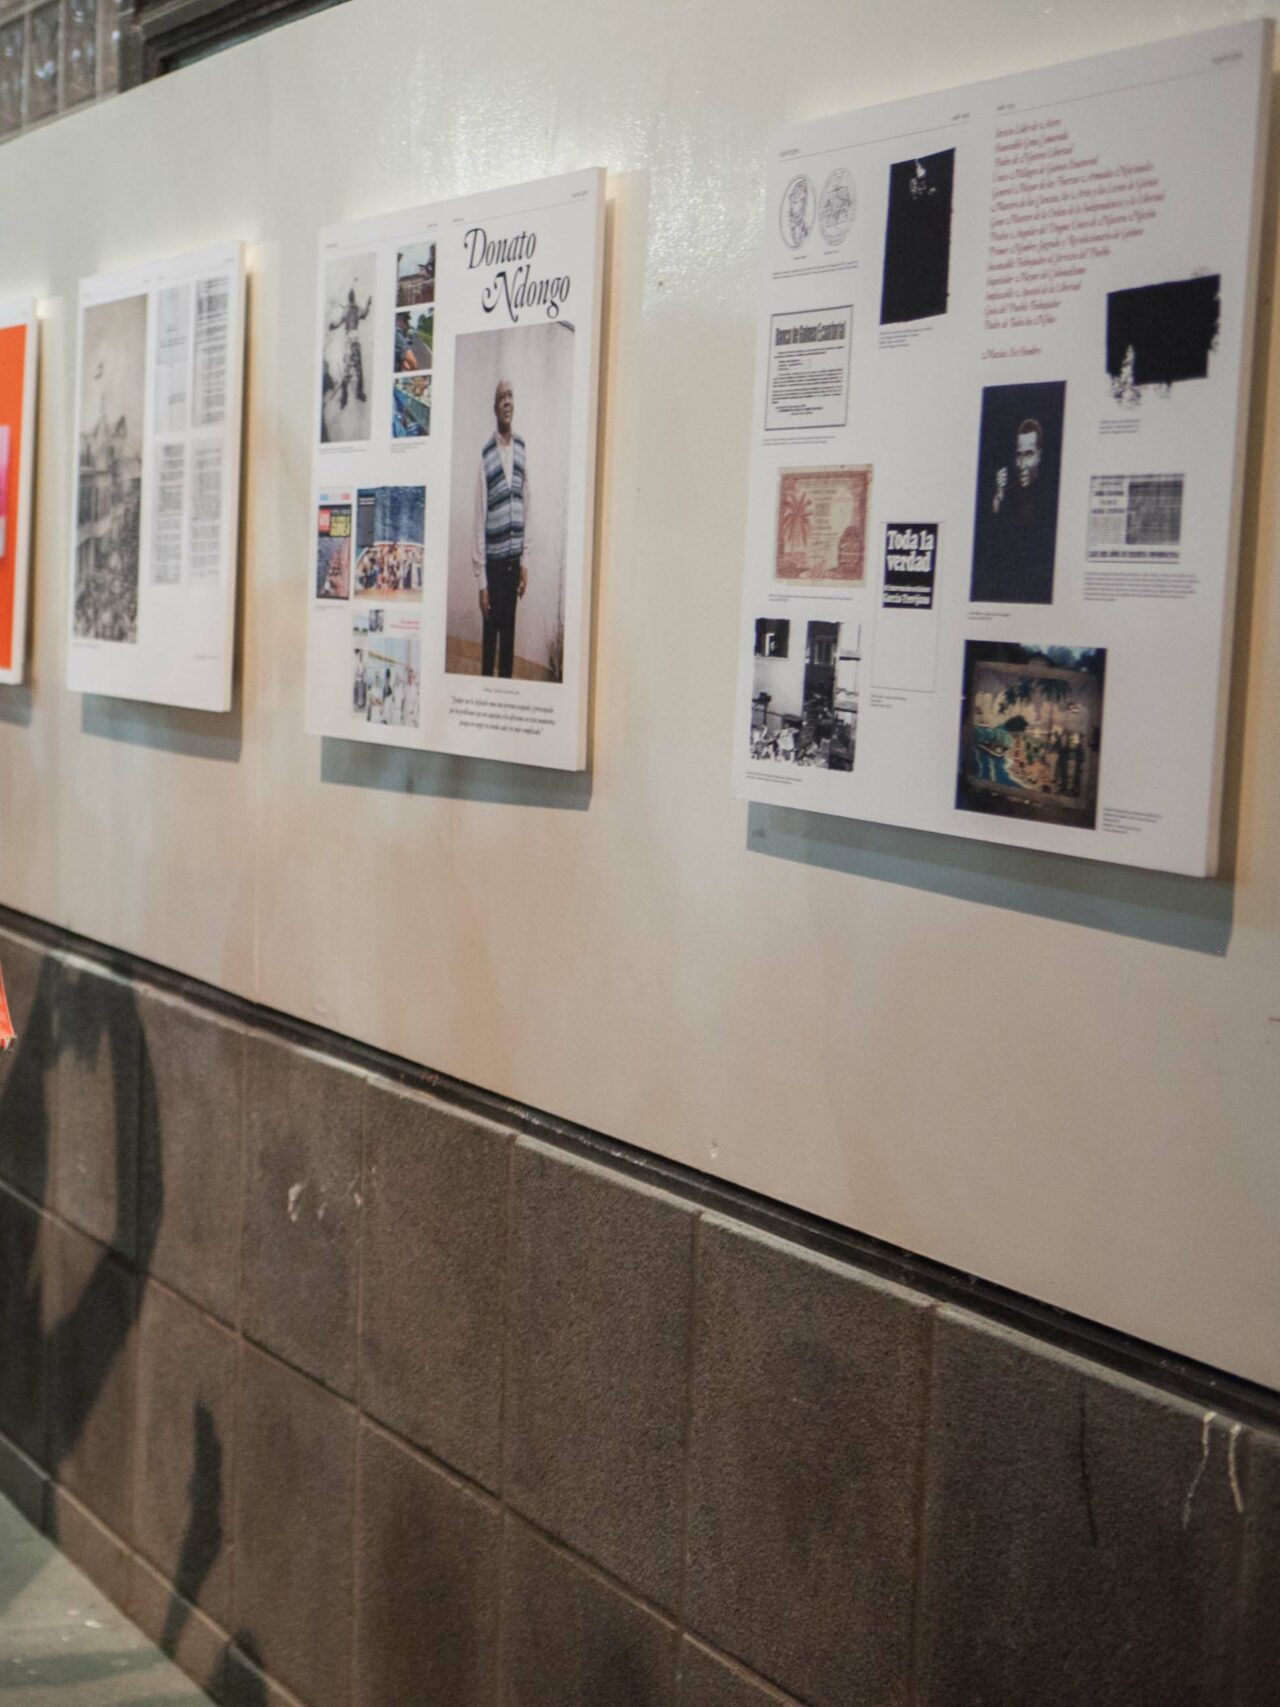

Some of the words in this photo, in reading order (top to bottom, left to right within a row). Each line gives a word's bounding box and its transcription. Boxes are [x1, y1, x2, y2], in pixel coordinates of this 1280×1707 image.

[464, 228, 537, 270] Donato
[482, 265, 570, 322] Ndongo
[886, 529, 919, 550] Toda
[919, 530, 934, 550] la
[886, 550, 932, 572] verdad
